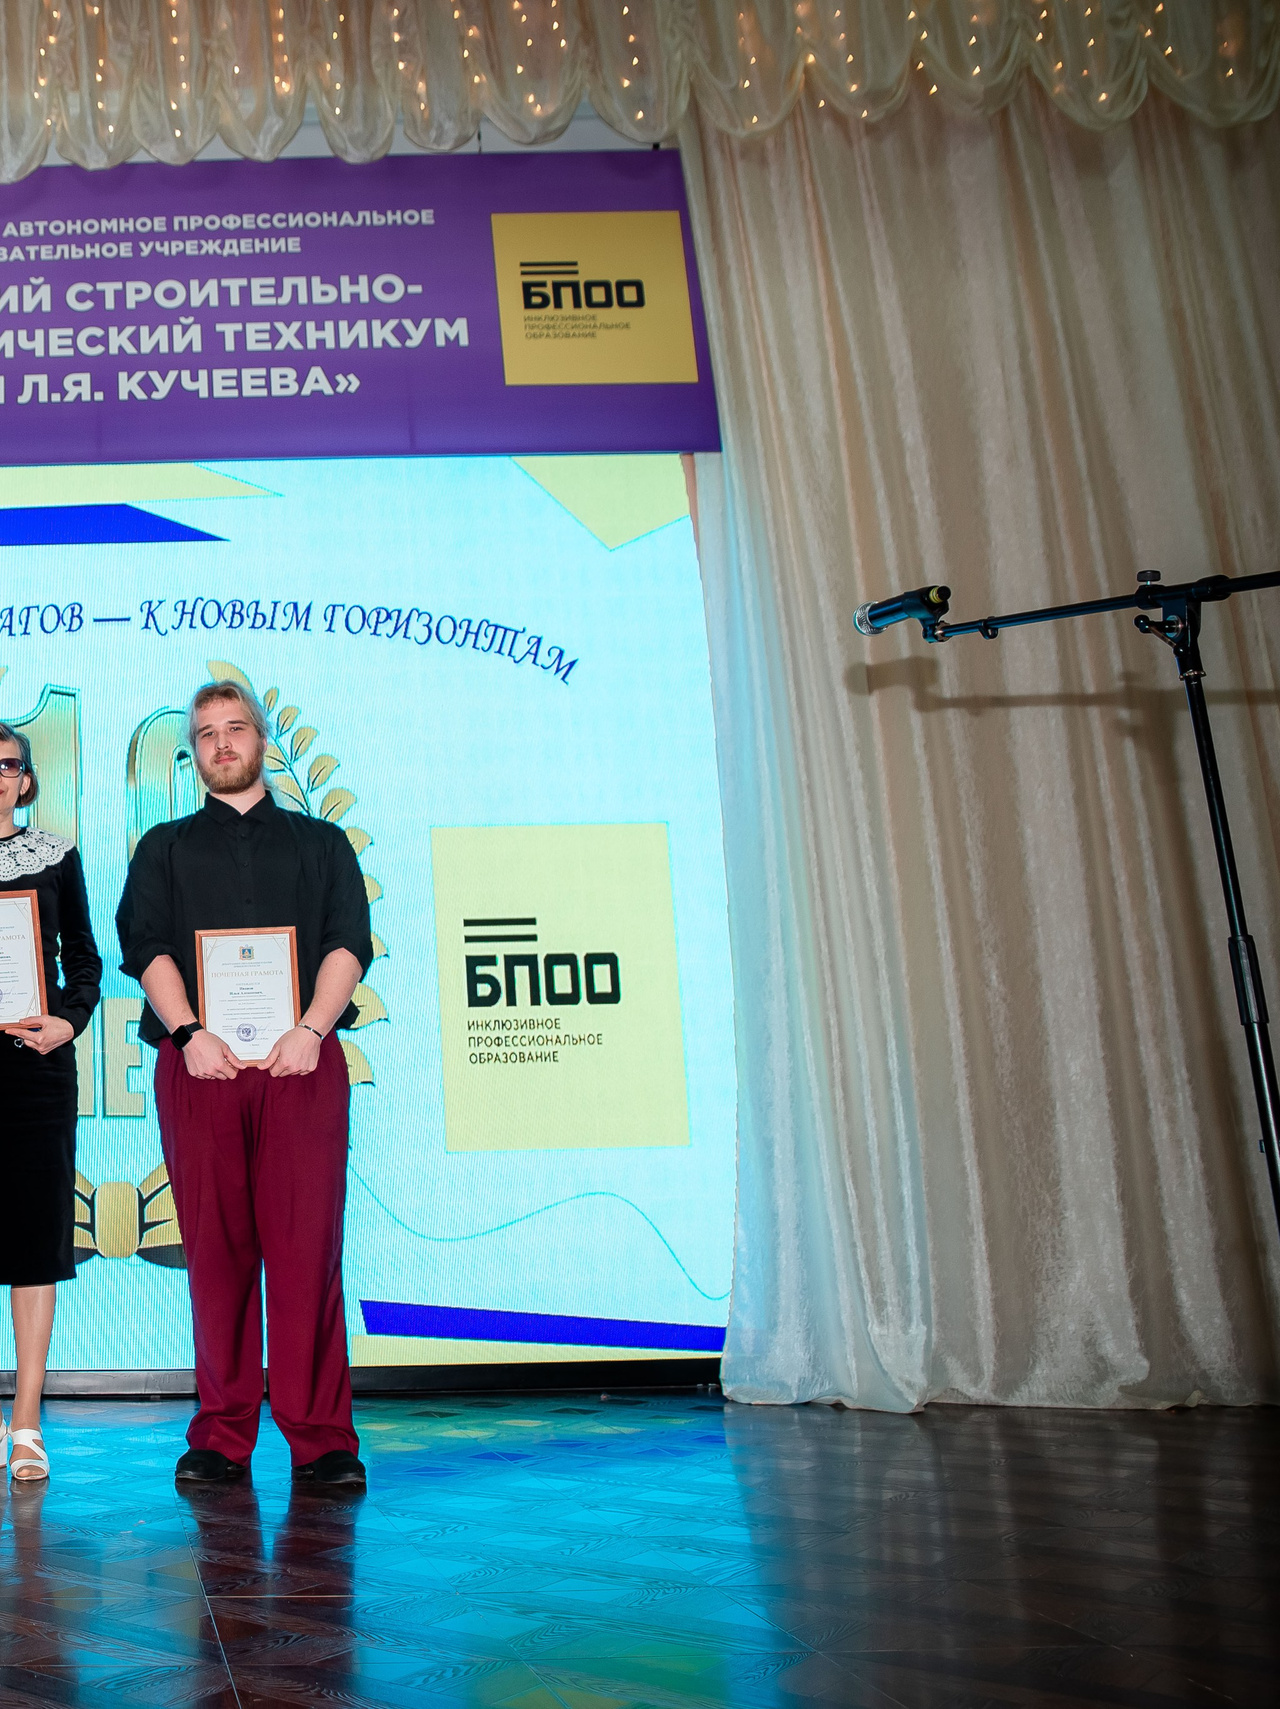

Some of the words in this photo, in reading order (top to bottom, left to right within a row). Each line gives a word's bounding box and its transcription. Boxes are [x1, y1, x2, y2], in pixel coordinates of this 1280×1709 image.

[3, 217, 167, 238] АВТОНОМНОЕ
[173, 209, 435, 231] ПРОФЕССИОНАЛЬНОЕ
[139, 237, 301, 257] УЧРЕЖДЕНИЕ
[66, 273, 423, 312] СТРОИТЕЛЬНО-
[522, 279, 645, 309] БПОО
[524, 313, 598, 321] ИНКЛЮЗИВНОЕ
[524, 321, 631, 331] ПРОФЕССИОНАЛЬНОЕ
[215, 317, 470, 352] ТЕХНИКУМ
[525, 331, 597, 339] ОБРАЗОВАНИЕ
[17, 372, 105, 404] Л.Я.
[118, 365, 361, 401] КУЧЕЕВА»
[171, 597, 314, 632] НОВЫМ
[323, 603, 579, 685] ГОРИЗОНТАМ
[211, 970, 250, 978] ПОЧЕТНАЯ
[250, 969, 284, 977] ГРАМОТА
[465, 952, 621, 1007] БПОО
[467, 1018, 561, 1031] ИНКЛЮЗИВНОЕ
[468, 1033, 603, 1048] ПРОФЕССИОНАЛЬНОЕ
[469, 1051, 559, 1064] ОБРАЗОВАНИЕ
